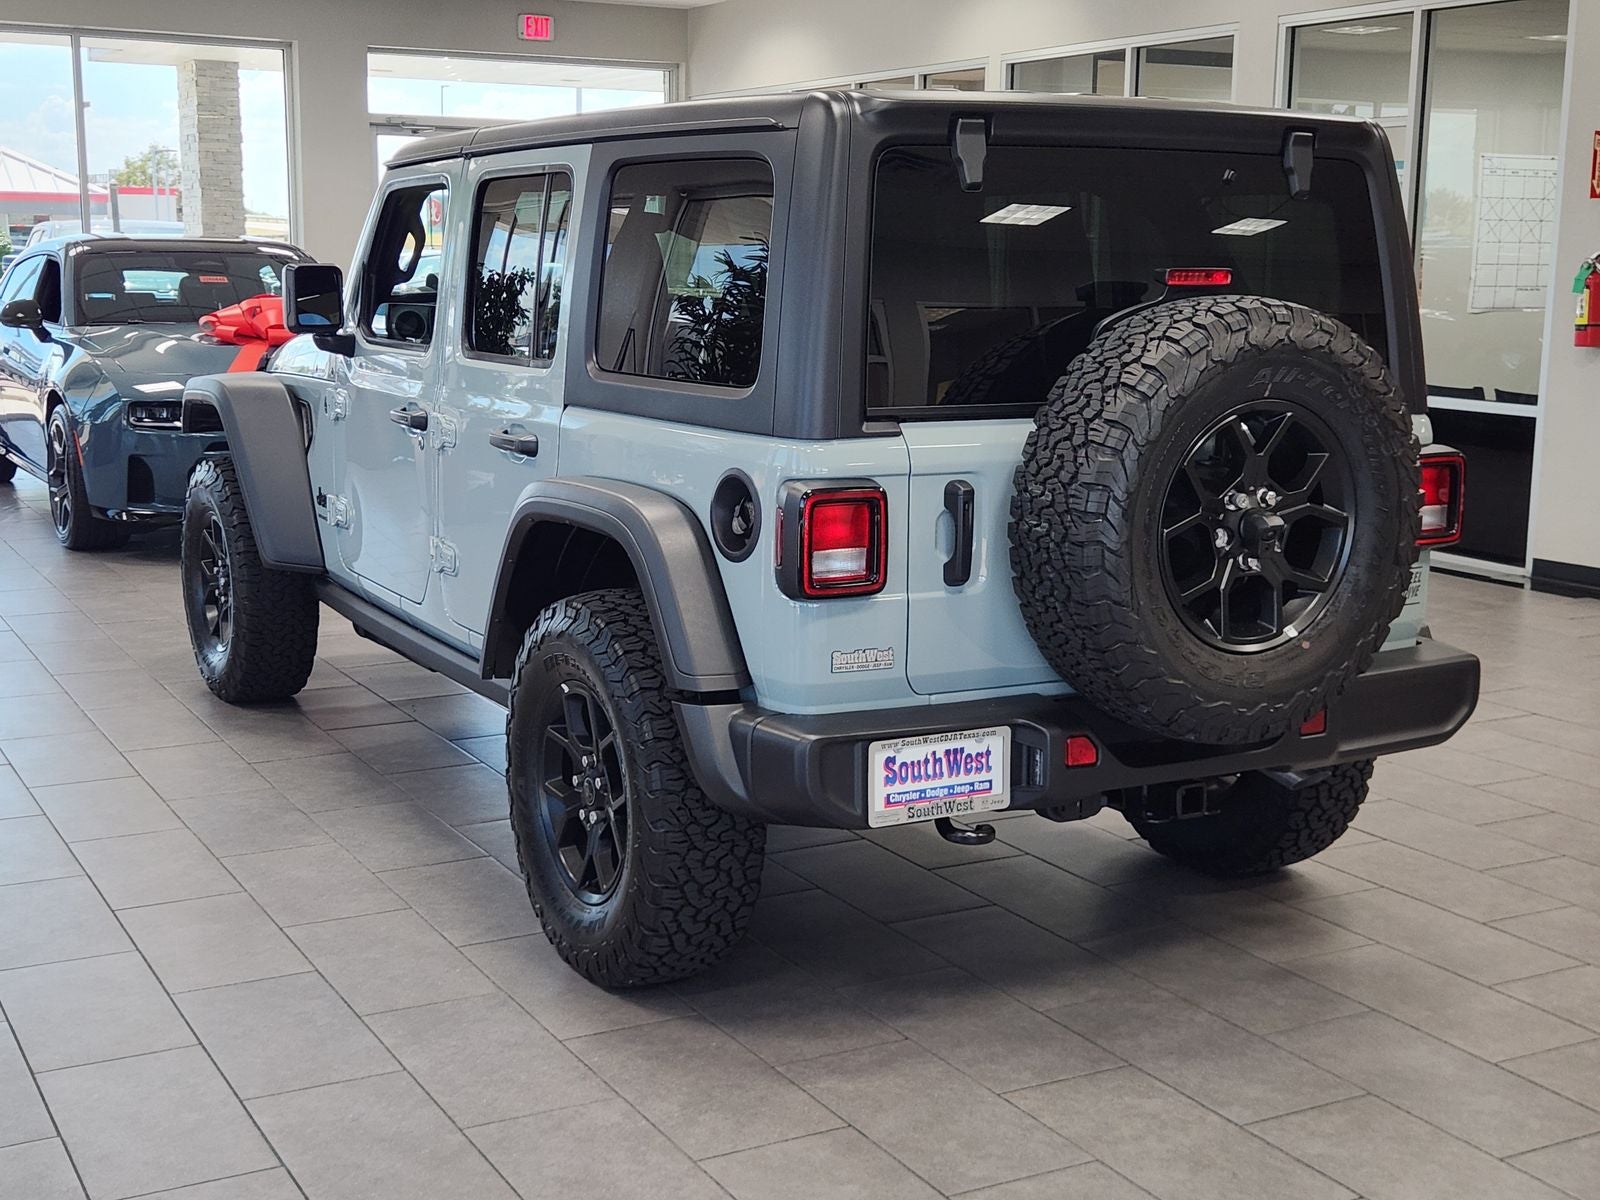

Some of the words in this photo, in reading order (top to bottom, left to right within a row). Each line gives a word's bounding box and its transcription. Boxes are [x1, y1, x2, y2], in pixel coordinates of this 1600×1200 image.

[525, 16, 550, 37] EXIT
[832, 648, 894, 665] SouthWest
[883, 744, 993, 787] SouthWest
[889, 790, 920, 803] Chrysler
[926, 786, 949, 799] Dodge
[953, 784, 970, 795] Jeep
[974, 780, 991, 791] Ram
[907, 798, 975, 819] SouthWest
